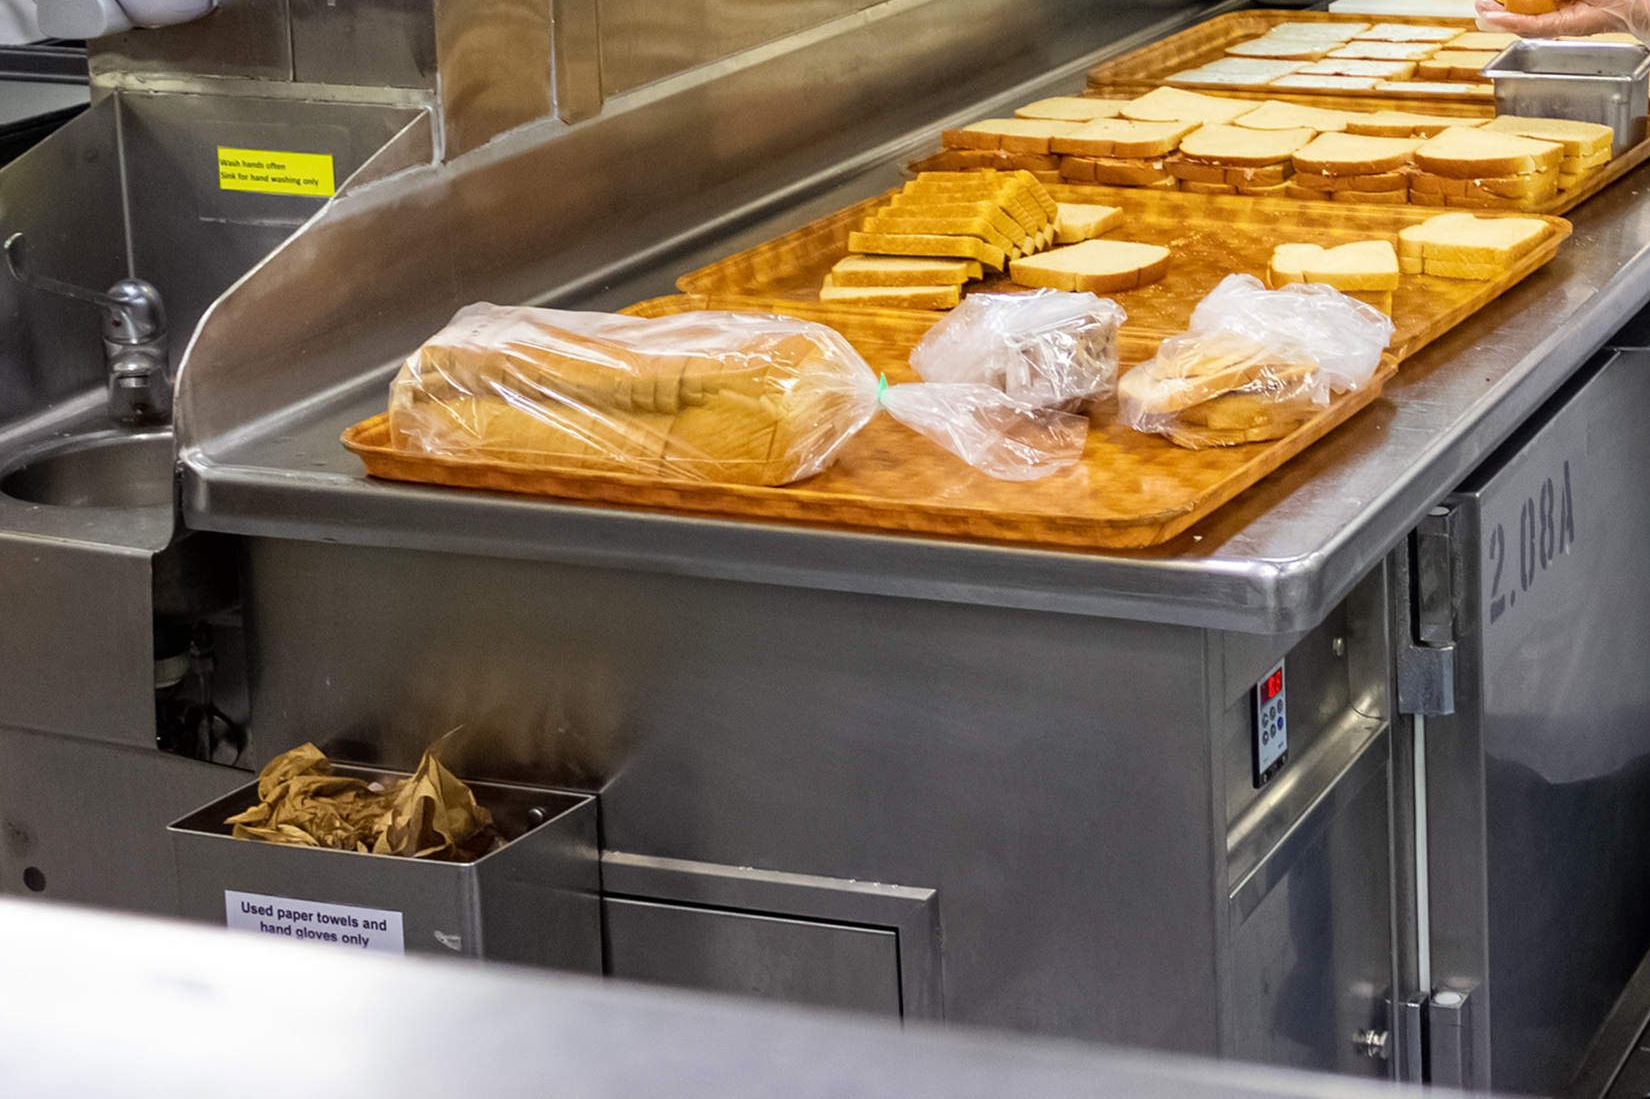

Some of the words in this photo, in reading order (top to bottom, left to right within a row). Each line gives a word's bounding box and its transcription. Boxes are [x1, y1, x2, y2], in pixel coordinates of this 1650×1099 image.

[242, 160, 265, 169] hands
[266, 162, 286, 170] often
[220, 172, 236, 180] Sink
[238, 172, 249, 181] for
[250, 174, 269, 182] hand
[271, 176, 301, 186] washing
[303, 178, 319, 187] only
[1489, 460, 1575, 626] 2.08A
[241, 901, 273, 917] Used
[278, 908, 313, 923] paper
[316, 912, 359, 928] towels
[362, 920, 387, 932] and
[260, 921, 292, 937] hand
[296, 926, 338, 943] gloves
[342, 933, 370, 949] only
